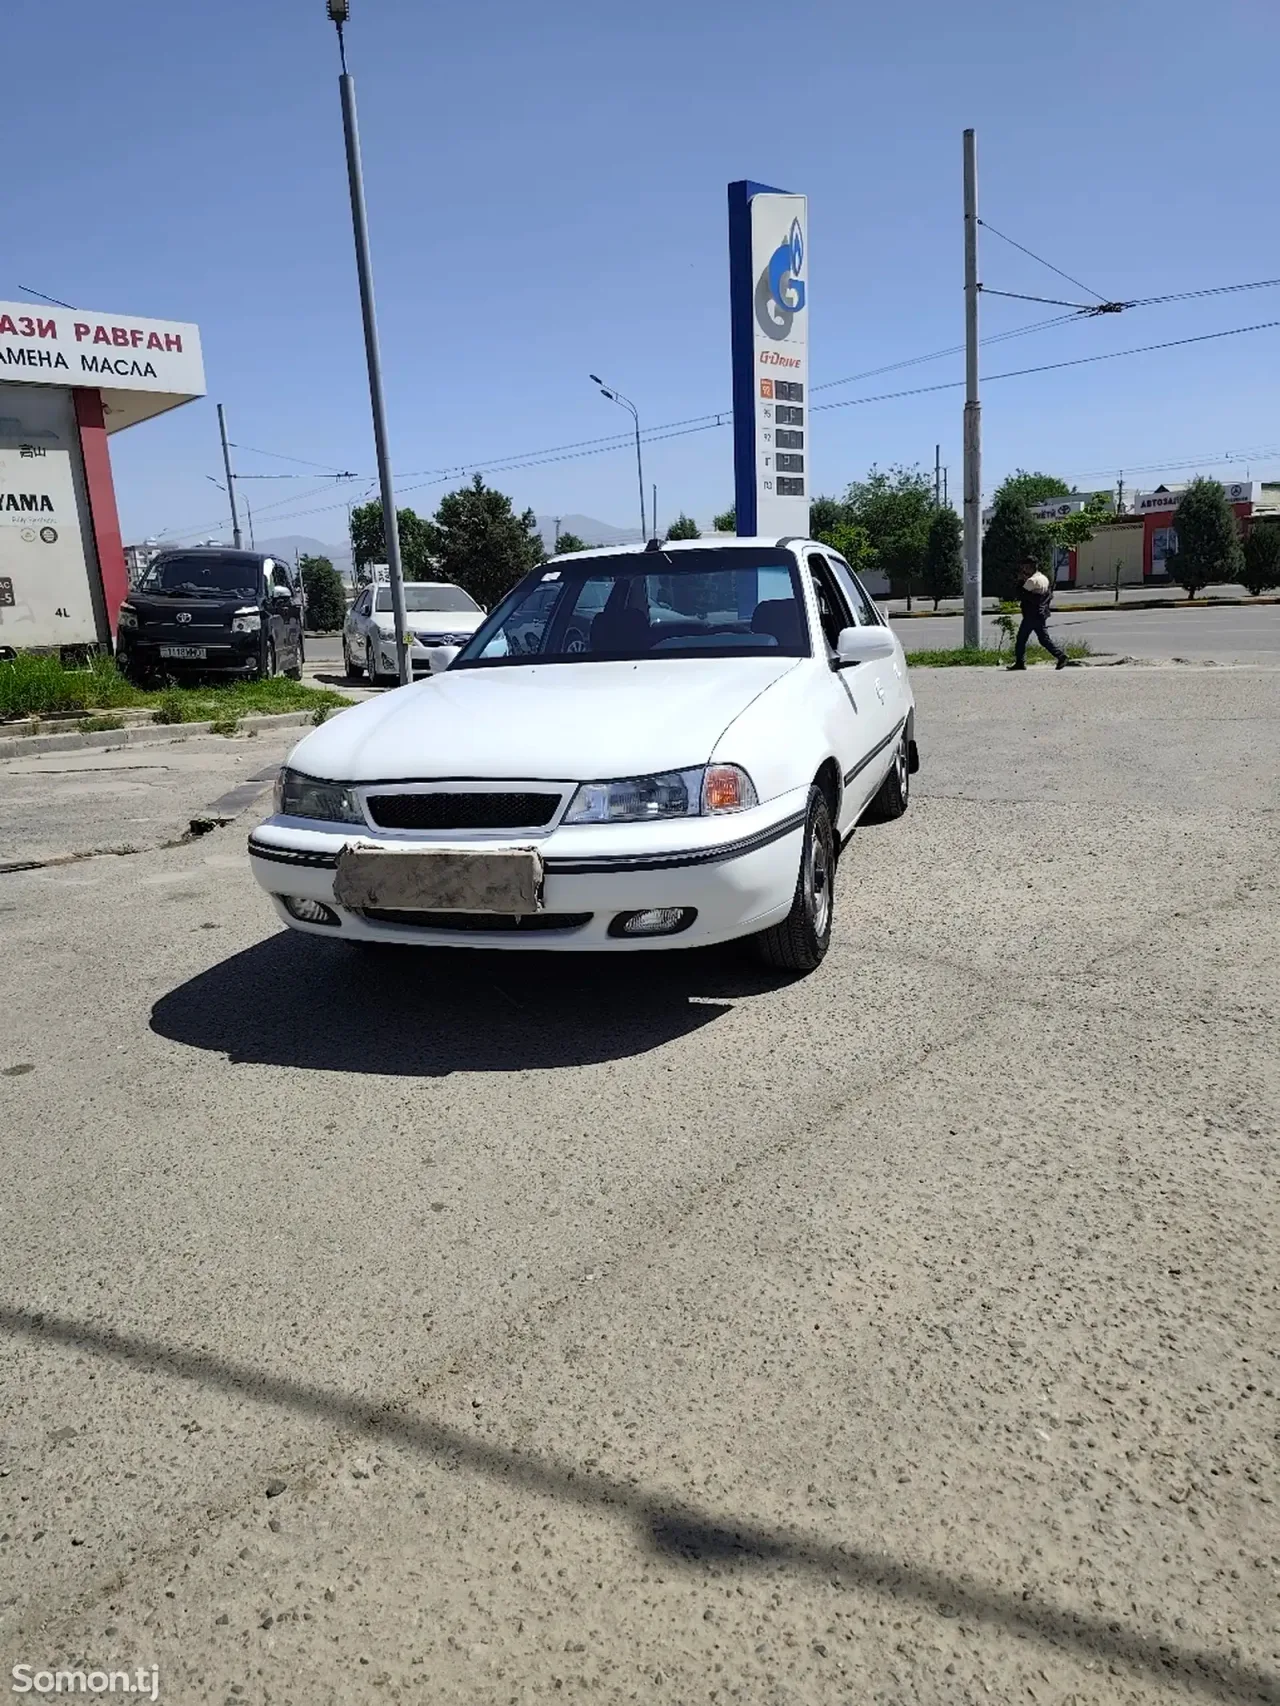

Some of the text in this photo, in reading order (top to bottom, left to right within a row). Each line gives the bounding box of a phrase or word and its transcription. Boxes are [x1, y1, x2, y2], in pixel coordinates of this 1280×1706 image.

[81, 354, 158, 378] МАСЛА
[19, 444, 46, 458] 高山
[55, 607, 71, 618] 4L
